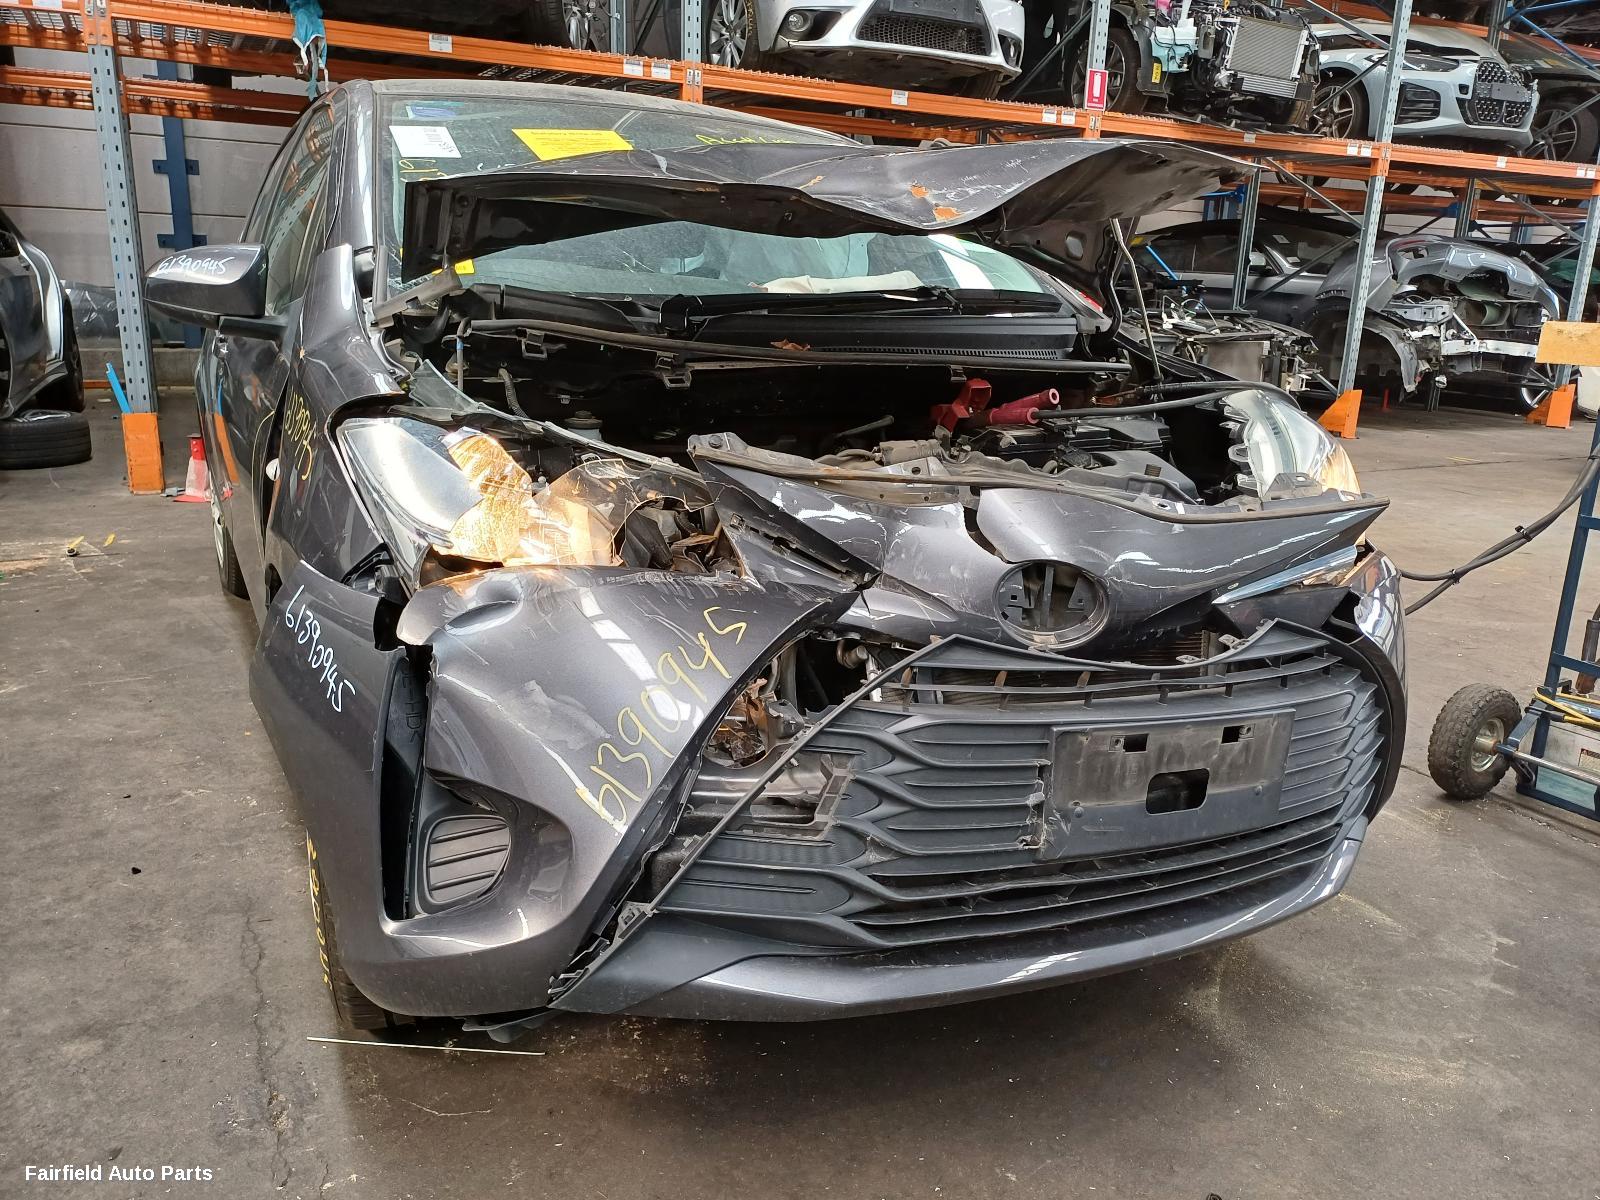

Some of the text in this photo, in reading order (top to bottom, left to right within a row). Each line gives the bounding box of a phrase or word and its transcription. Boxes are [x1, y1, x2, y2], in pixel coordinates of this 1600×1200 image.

[157, 254, 235, 275] 61390945
[285, 585, 356, 713] 61390945
[575, 606, 748, 829] 61390945
